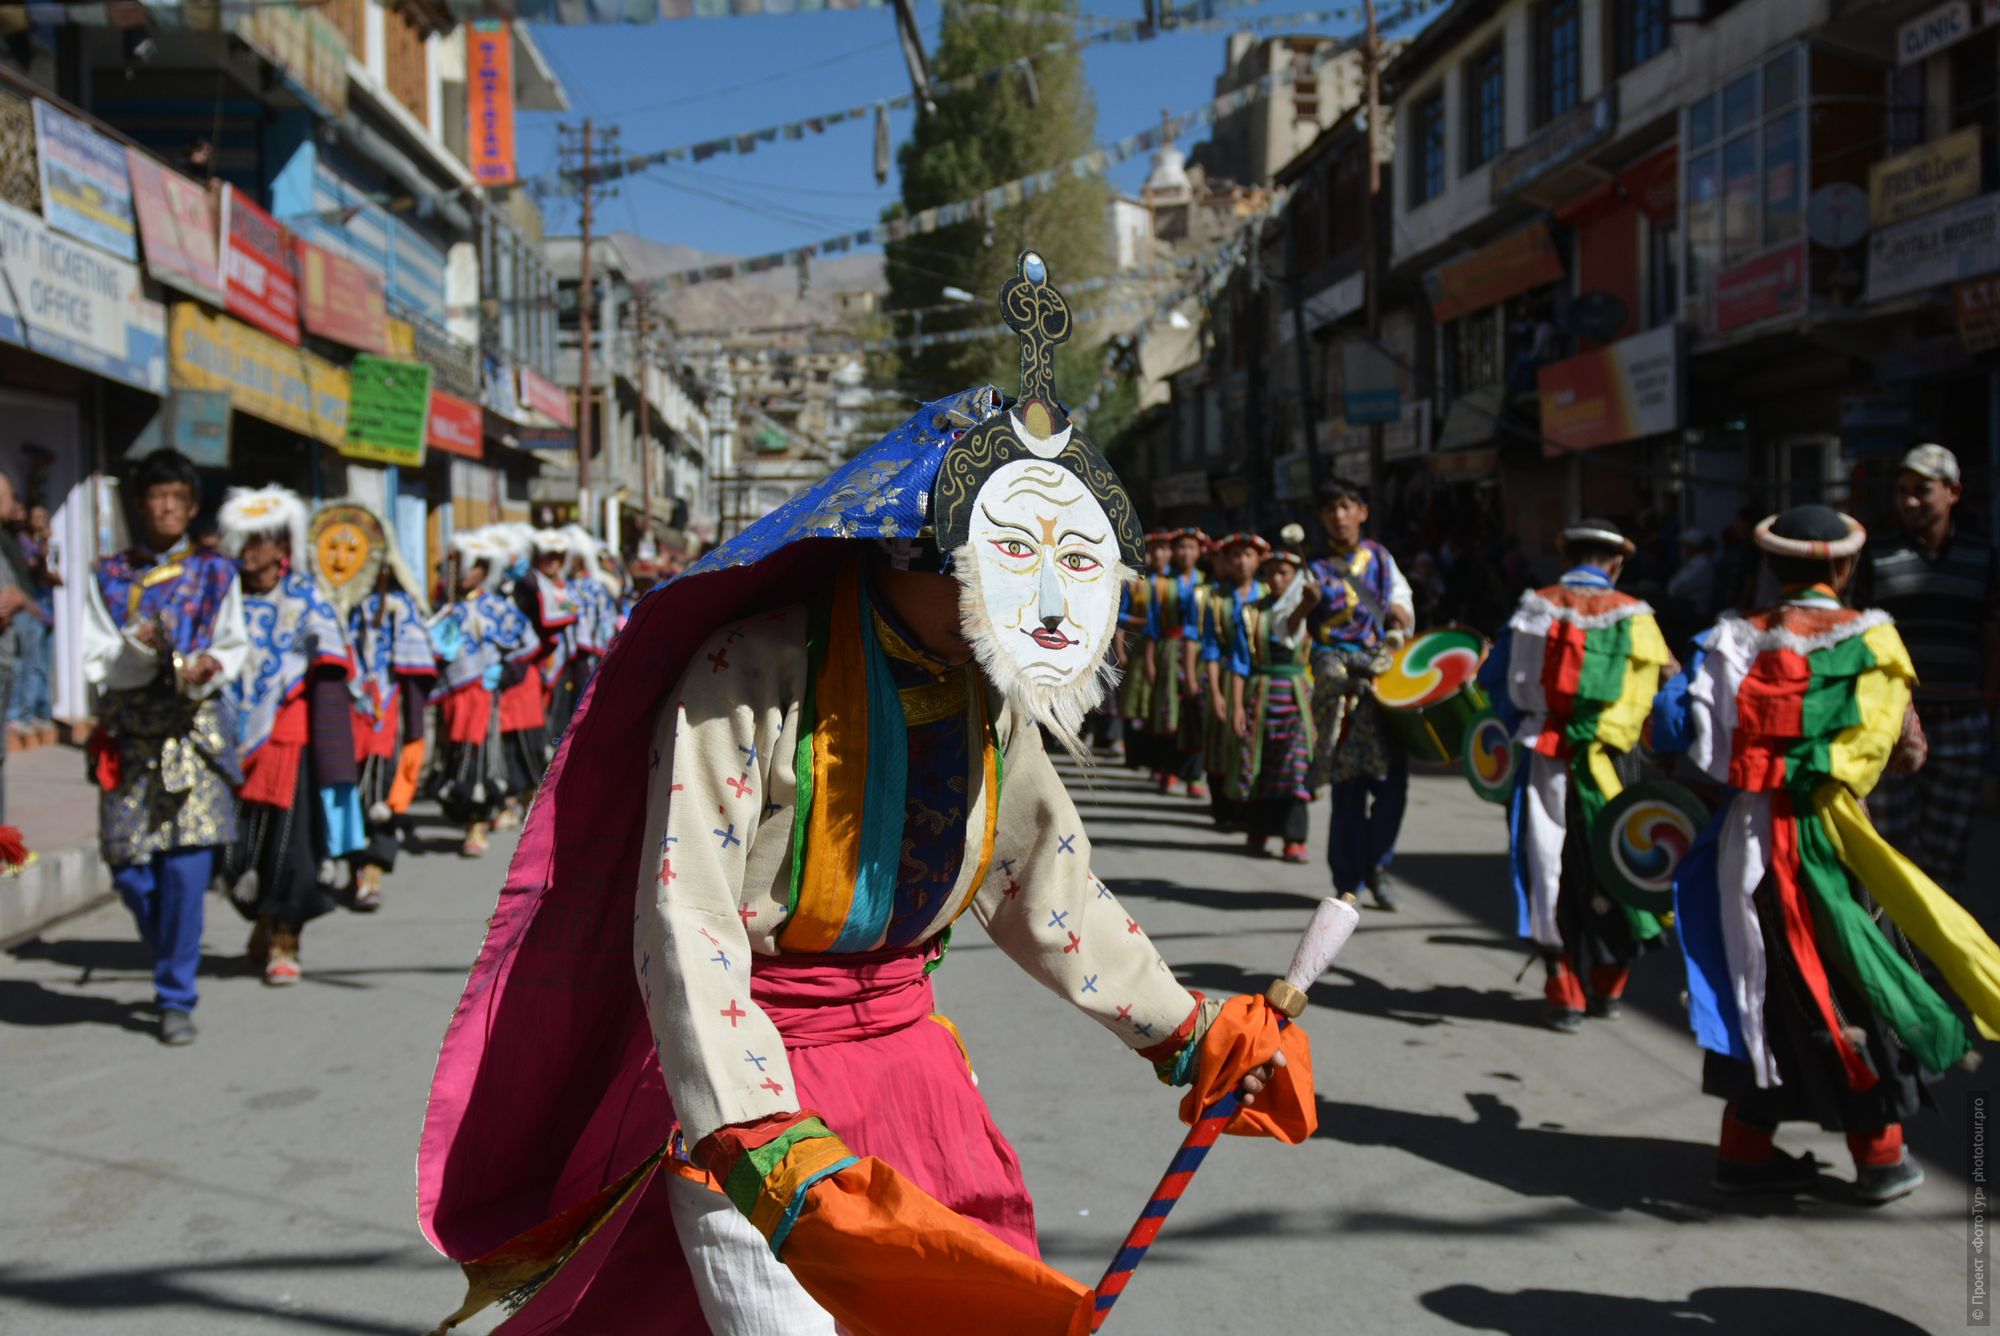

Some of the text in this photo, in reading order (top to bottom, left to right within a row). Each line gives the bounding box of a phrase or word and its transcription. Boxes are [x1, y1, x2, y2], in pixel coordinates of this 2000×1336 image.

[1906, 10, 1962, 54] CLINIC
[36, 232, 119, 300] TICKETING
[30, 277, 92, 333] OFFICE
